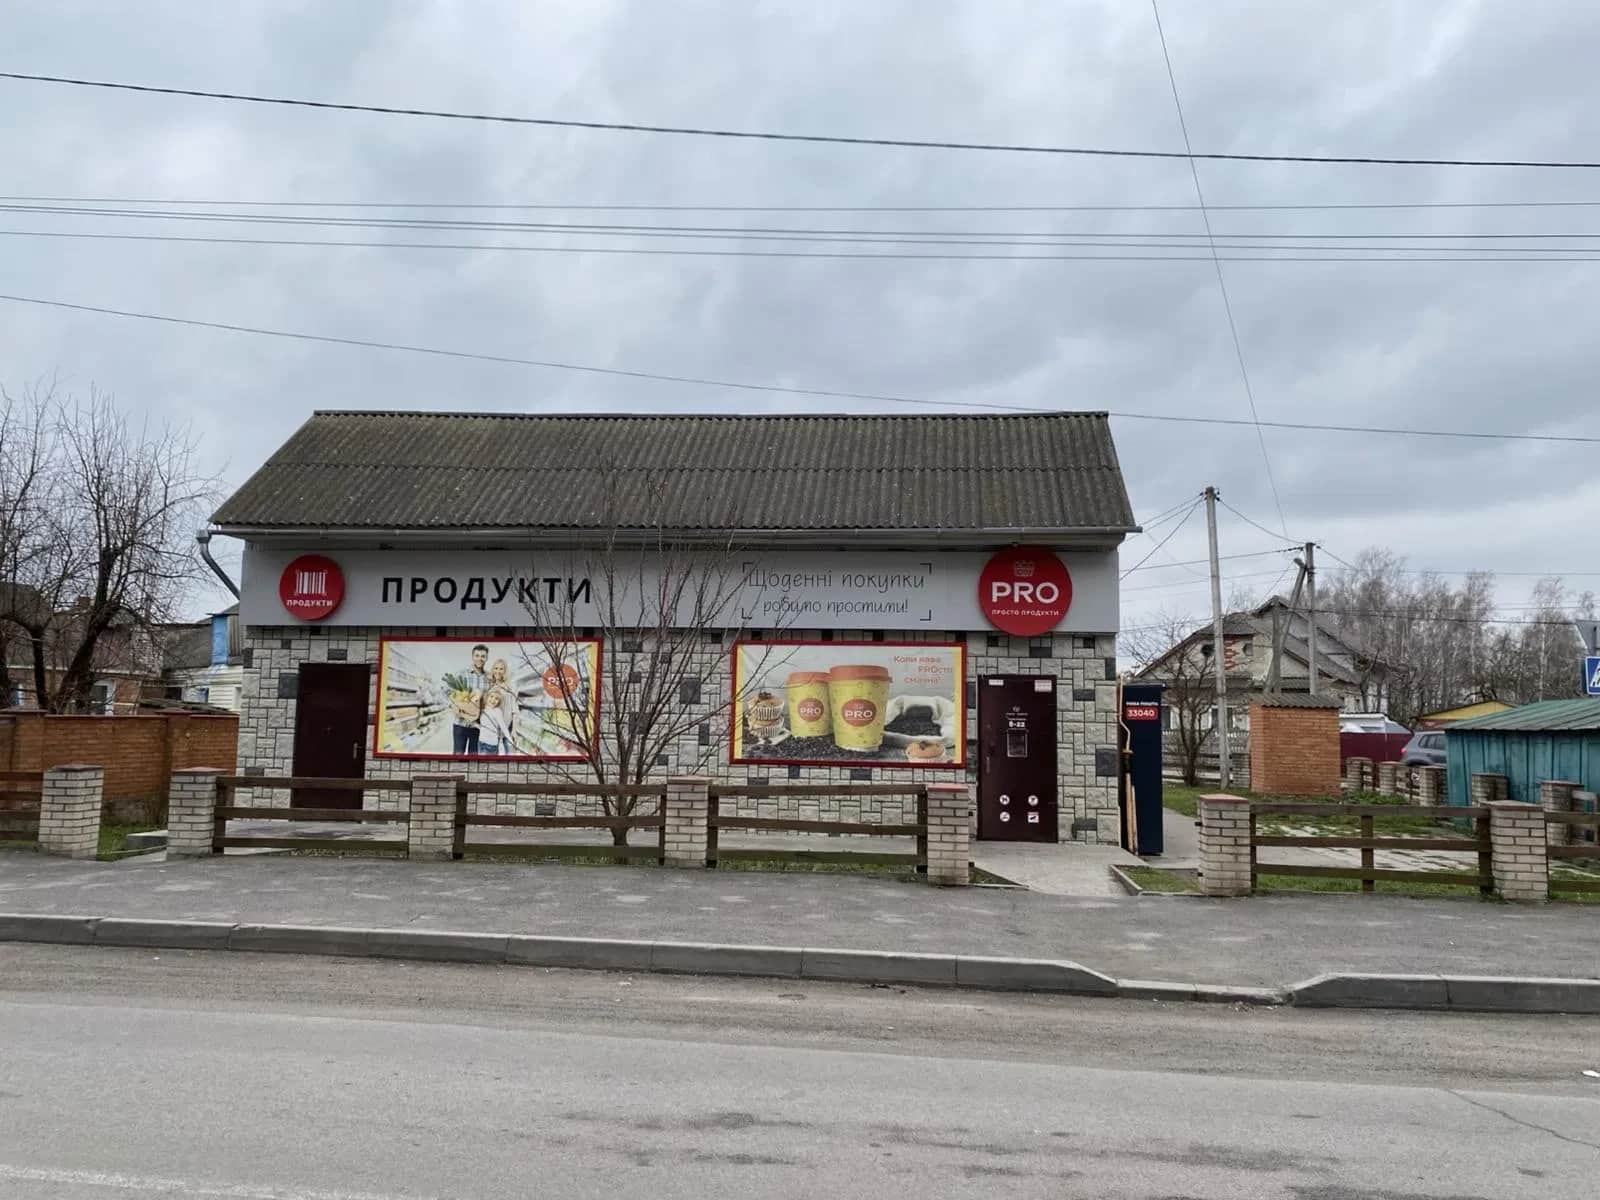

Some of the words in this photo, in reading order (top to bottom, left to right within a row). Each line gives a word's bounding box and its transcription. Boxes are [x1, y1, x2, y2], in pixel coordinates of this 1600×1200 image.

[748, 569, 832, 592] Щоденні
[842, 574, 924, 593] покупки
[382, 577, 591, 610] ПРОДУКТИ
[991, 581, 1059, 604] PRO
[286, 599, 334, 608] ПРОДУКТИ
[763, 597, 822, 616] робимо
[827, 600, 909, 616] простими!
[991, 608, 1020, 616] ПРОСТО
[1021, 609, 1060, 617] ПРОДУКТИ
[800, 707, 822, 715] PRO
[845, 709, 873, 719] PRO
